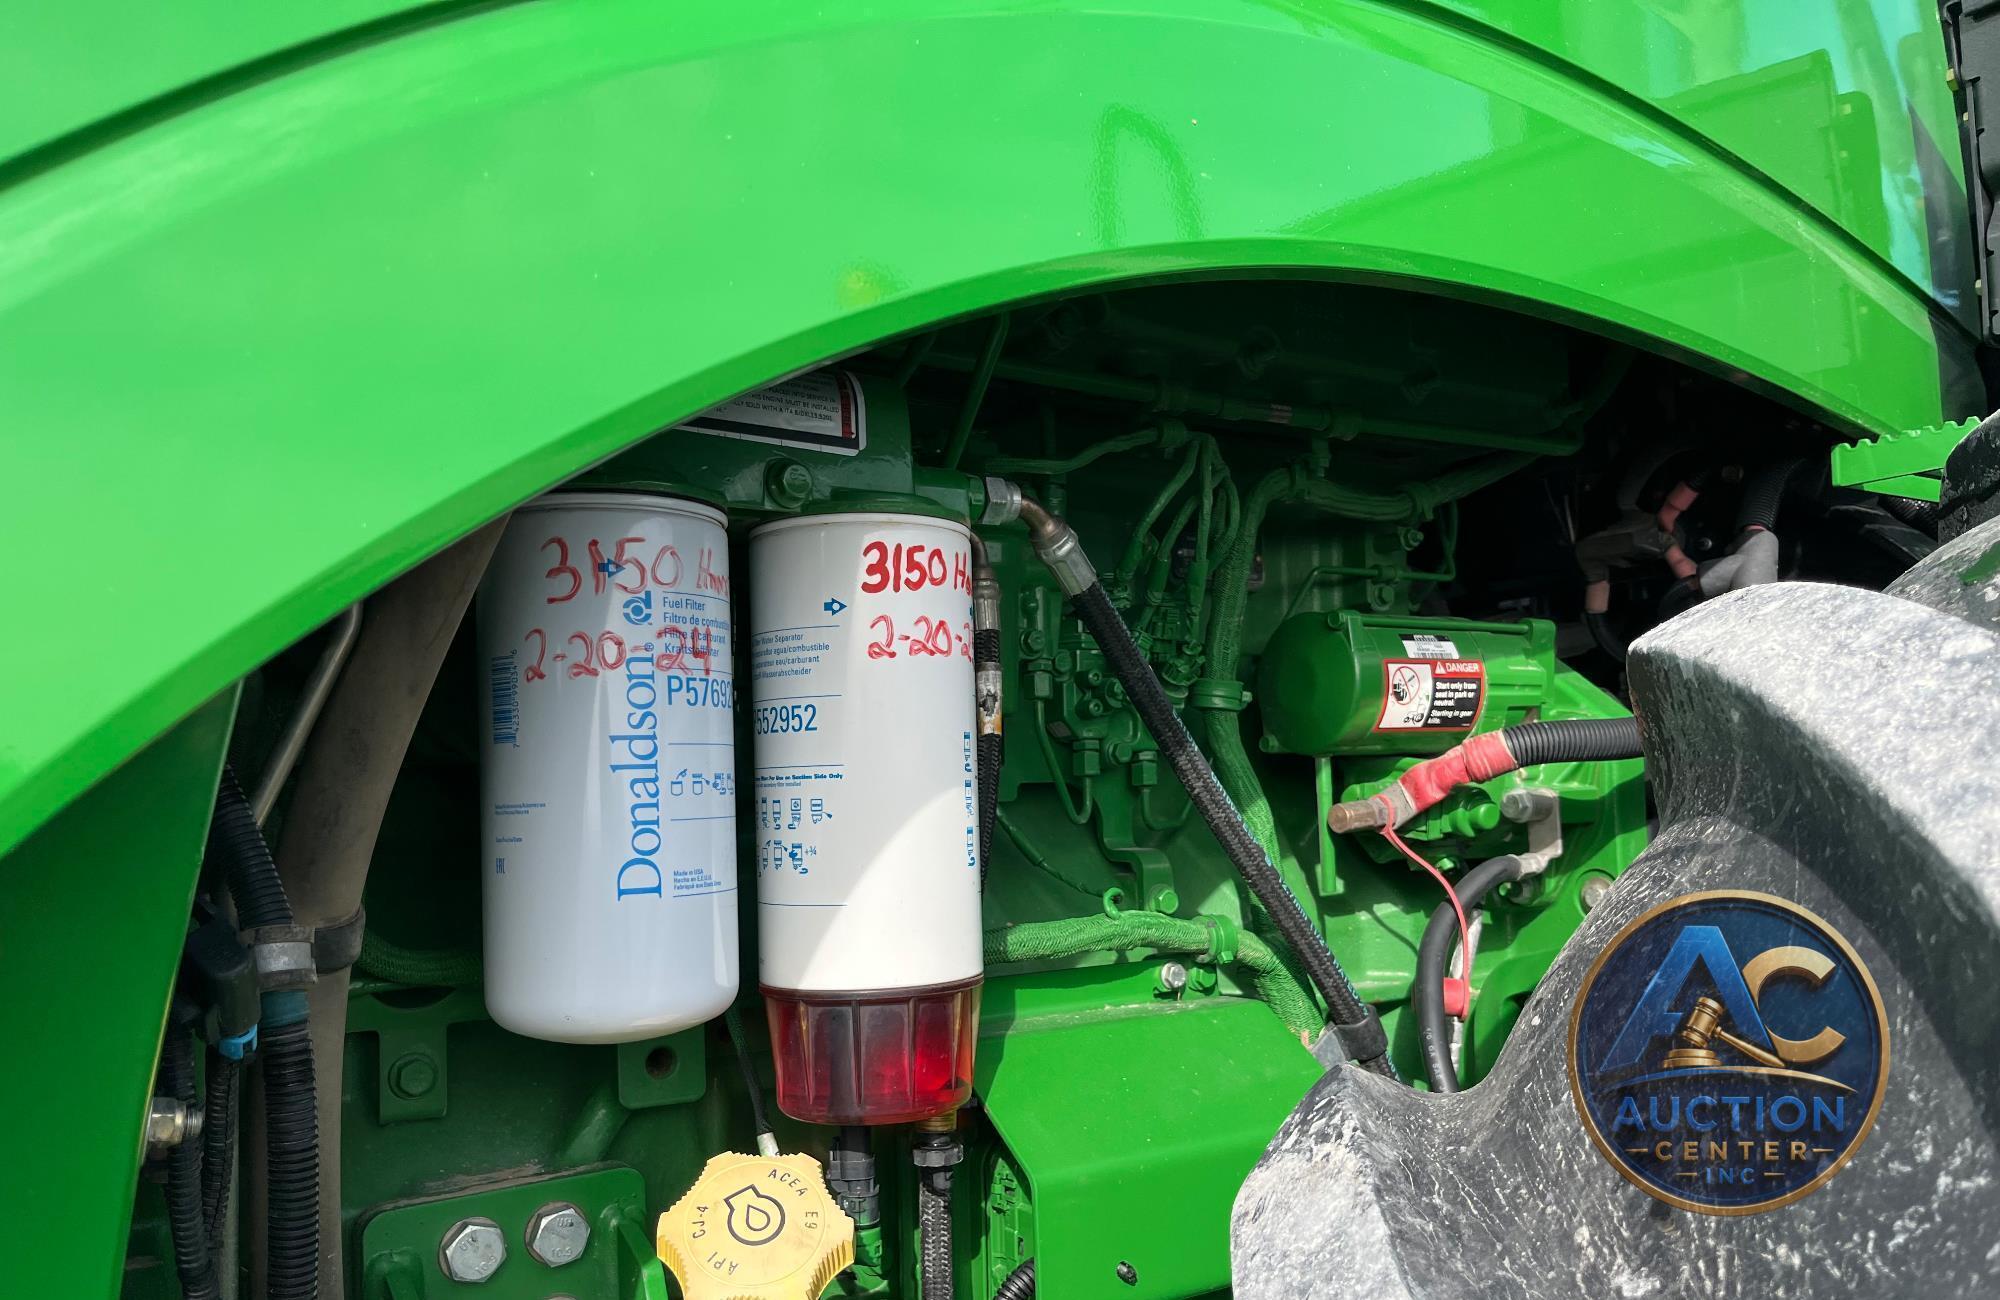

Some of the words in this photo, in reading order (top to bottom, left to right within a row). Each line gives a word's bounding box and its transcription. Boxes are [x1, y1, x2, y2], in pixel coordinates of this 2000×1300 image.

[761, 404, 778, 412] WITH
[541, 537, 684, 604] 3150
[861, 541, 947, 593] 3150
[663, 597, 682, 609] Fuel
[685, 598, 705, 611] Filter
[663, 612, 687, 625] Filtro
[689, 614, 699, 626] de
[775, 633, 804, 643] Separator
[525, 625, 712, 682] 2-20-24
[773, 643, 830, 655] agua/combustible
[775, 655, 820, 666] eau/carburant
[1445, 662, 1479, 673] DANGER
[1435, 681, 1450, 690] Start
[1450, 682, 1463, 691] only
[1463, 682, 1477, 690] from
[1455, 691, 1467, 700] park
[1430, 710, 1452, 718] Starting
[608, 653, 662, 901] Donaldson
[829, 772, 843, 780] Only
[768, 1168, 808, 1197] ACEA
[805, 1211, 818, 1230] E9
[692, 1205, 709, 1239] CJ-4
[707, 1251, 739, 1276] API
